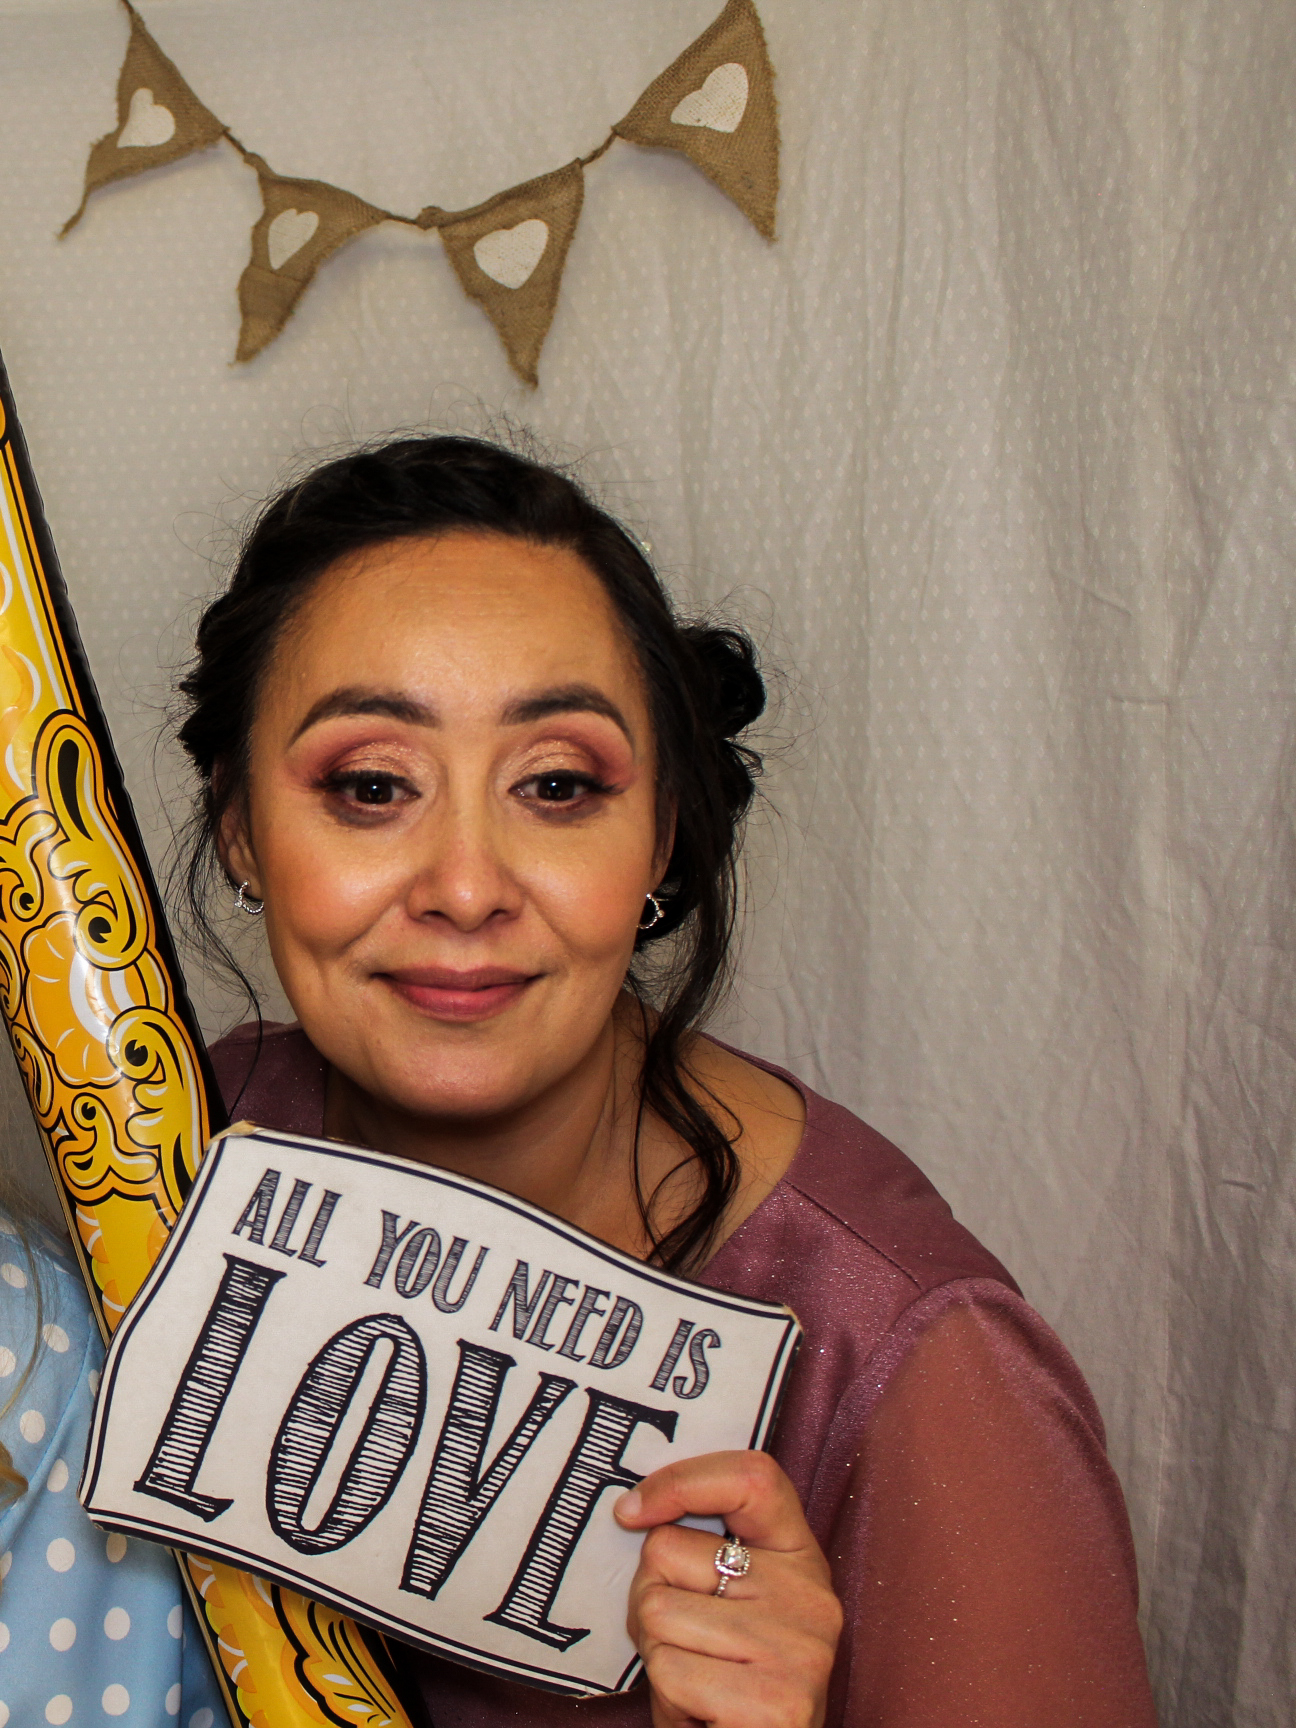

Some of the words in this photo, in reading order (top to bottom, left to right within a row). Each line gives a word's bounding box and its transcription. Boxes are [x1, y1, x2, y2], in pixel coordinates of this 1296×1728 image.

[231, 1167, 343, 1267] ALL
[364, 1209, 490, 1314] YOU
[488, 1259, 645, 1371] NEED
[649, 1318, 722, 1400] IS
[133, 1252, 679, 1652] LOVE
